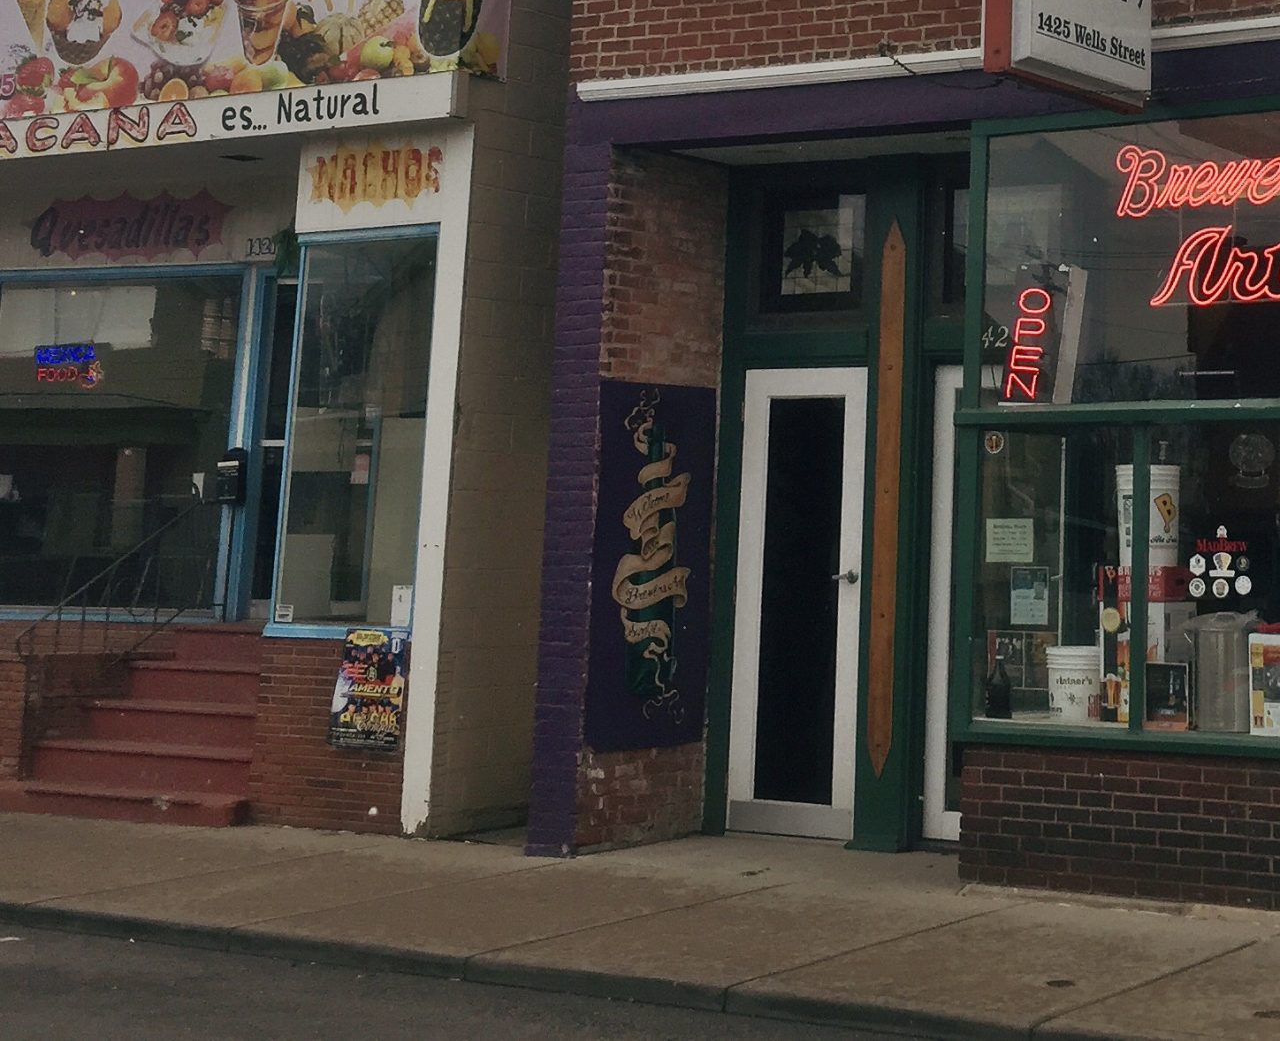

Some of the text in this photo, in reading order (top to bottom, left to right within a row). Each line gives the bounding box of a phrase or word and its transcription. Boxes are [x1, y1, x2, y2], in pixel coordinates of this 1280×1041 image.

[1037, 11, 1146, 67] 1425 Wells Street
[277, 83, 380, 125] Natural
[1005, 287, 1051, 400] OPEN
[37, 365, 78, 382] FOOD
